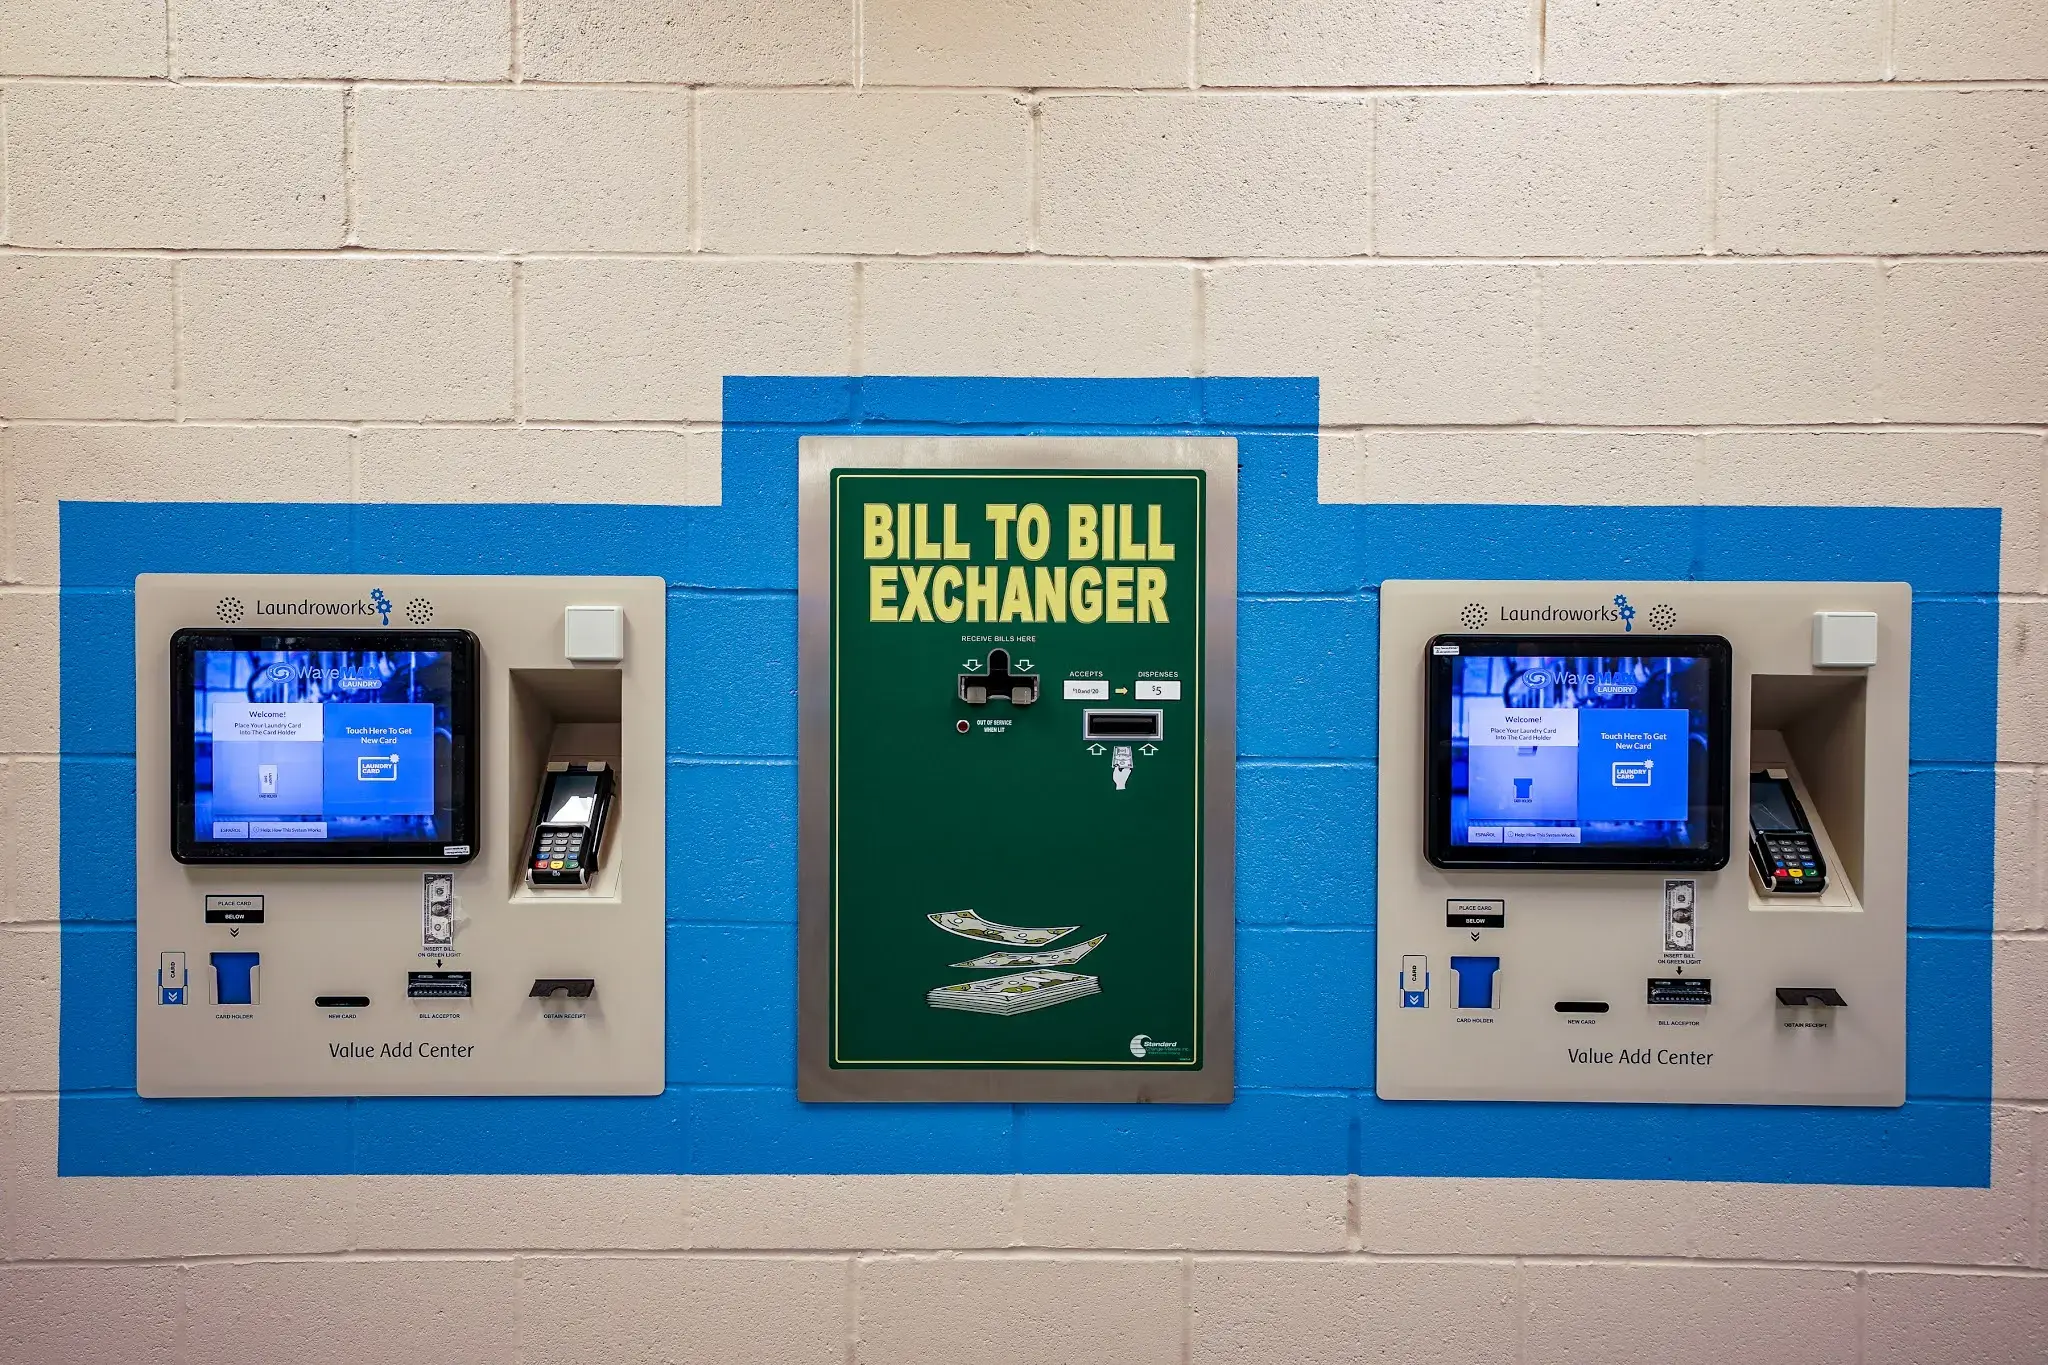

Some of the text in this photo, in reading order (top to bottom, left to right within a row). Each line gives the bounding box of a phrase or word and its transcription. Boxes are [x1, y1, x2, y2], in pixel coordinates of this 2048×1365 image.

[864, 502, 1176, 561] BILL TO BILL
[869, 564, 1170, 624] EXCHANGER
[257, 599, 375, 616] Laundroworks
[1501, 605, 1618, 622] Laundroworks
[1152, 686, 1162, 696] $5
[329, 1042, 474, 1058] Value Add Center
[1568, 1048, 1713, 1065] Value Add Center
